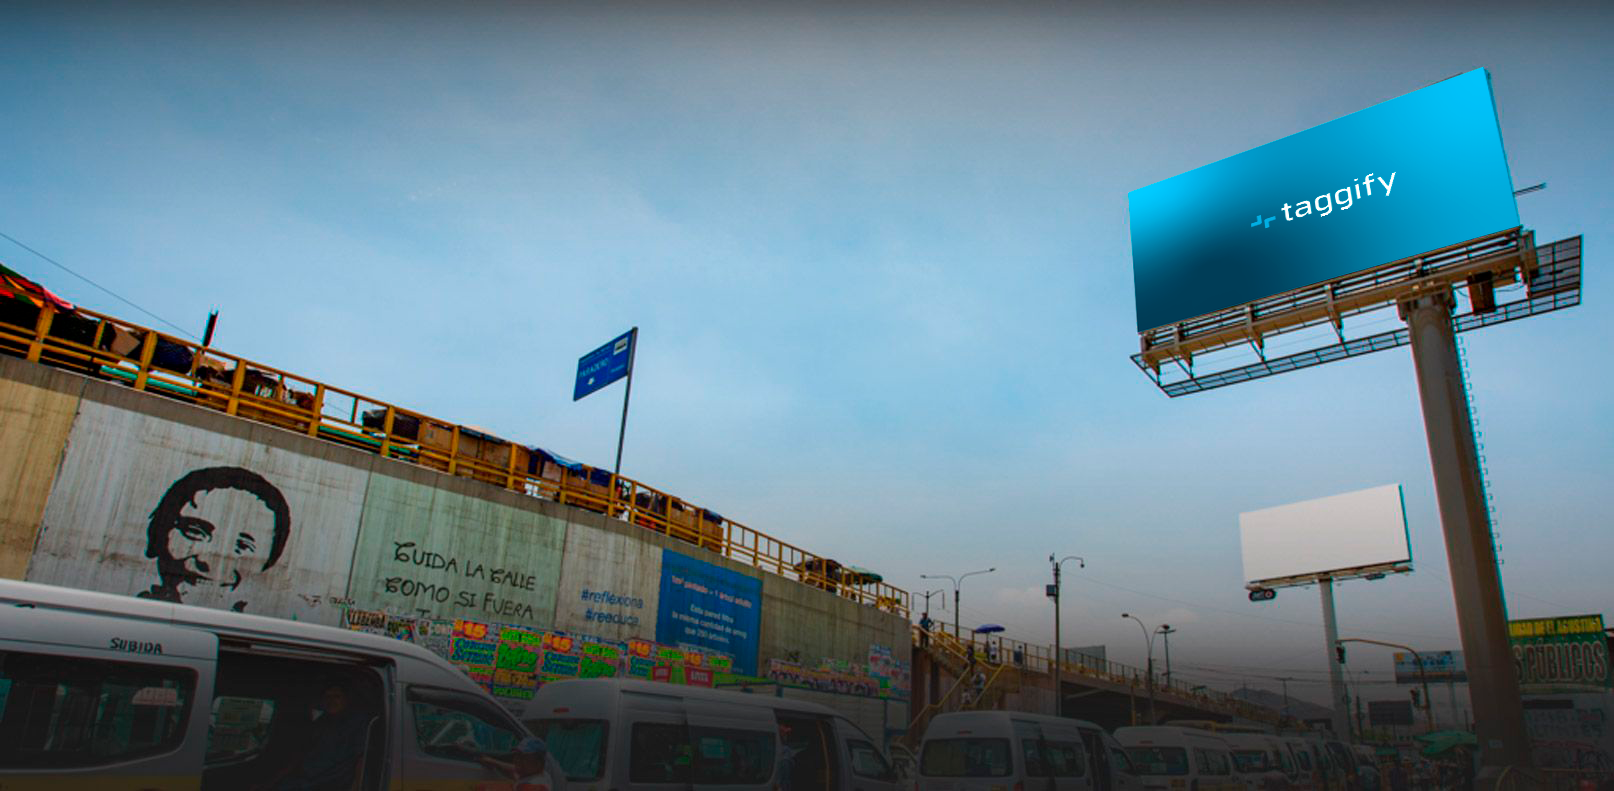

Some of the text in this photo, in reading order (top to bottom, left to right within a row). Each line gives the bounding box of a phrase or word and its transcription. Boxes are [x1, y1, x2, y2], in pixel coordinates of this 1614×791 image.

[1281, 171, 1397, 222] taggify
[465, 560, 485, 580] LA
[490, 568, 537, 592] CALLE
[385, 577, 450, 604] COMO
[454, 591, 478, 608] SI
[483, 592, 534, 621] FUERA
[110, 636, 163, 656] SUBIDA
